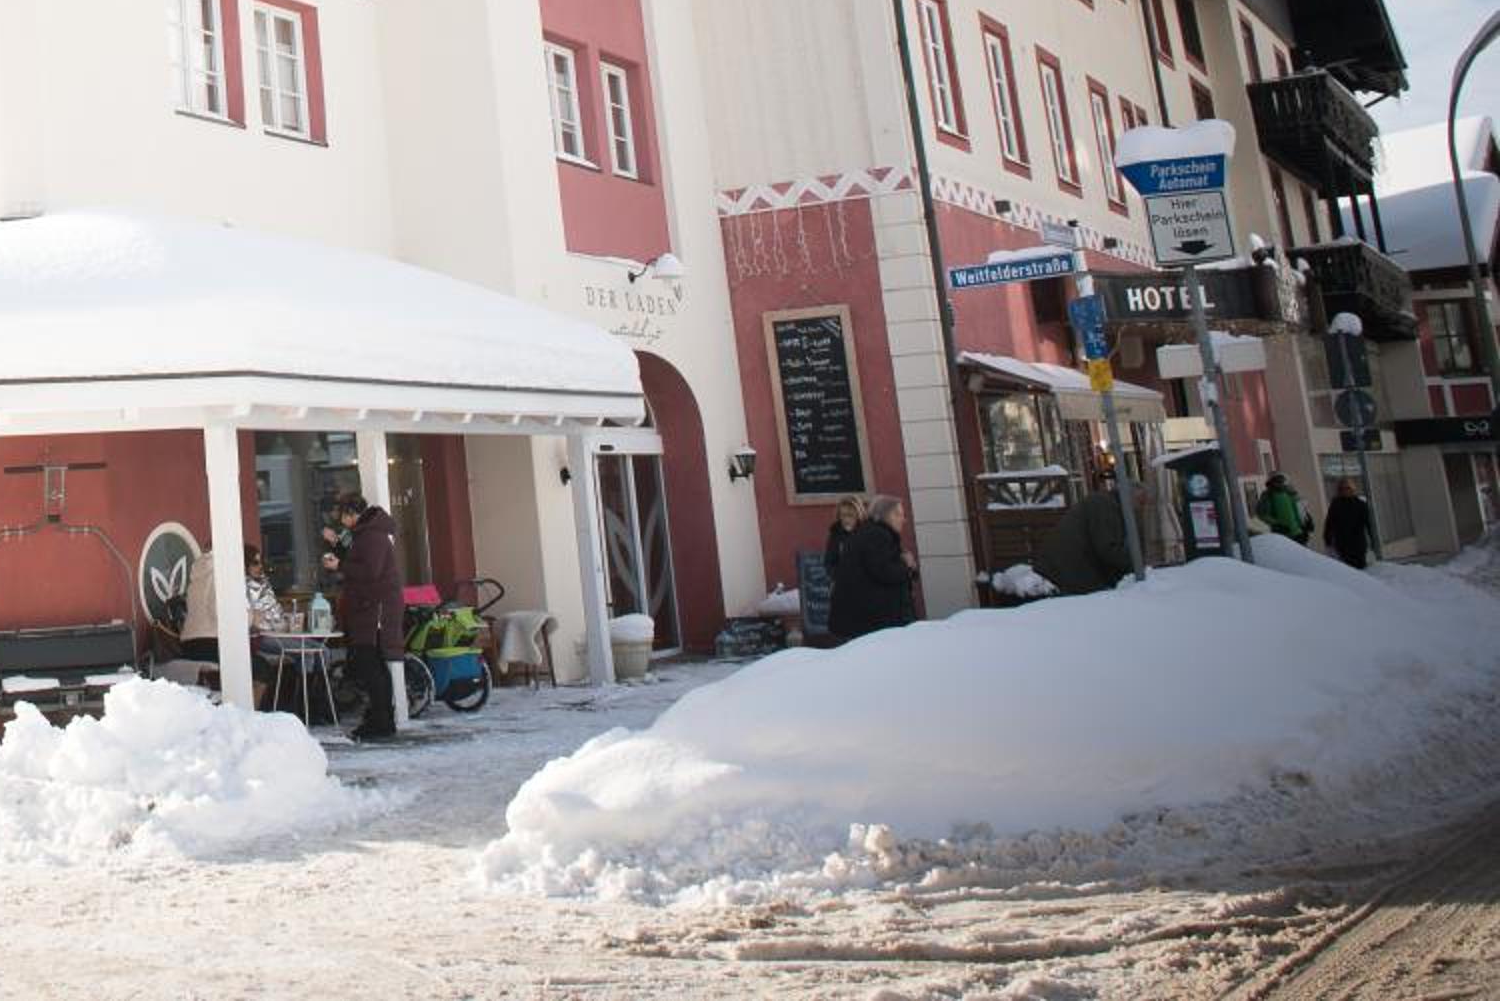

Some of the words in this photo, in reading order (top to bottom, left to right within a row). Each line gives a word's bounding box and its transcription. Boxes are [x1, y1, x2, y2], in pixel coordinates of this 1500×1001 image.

[1150, 160, 1217, 177] Parkschein
[1158, 175, 1209, 190] Automat
[955, 258, 1070, 285] Weitfelderstraße
[1126, 285, 1216, 312] HOTEL
